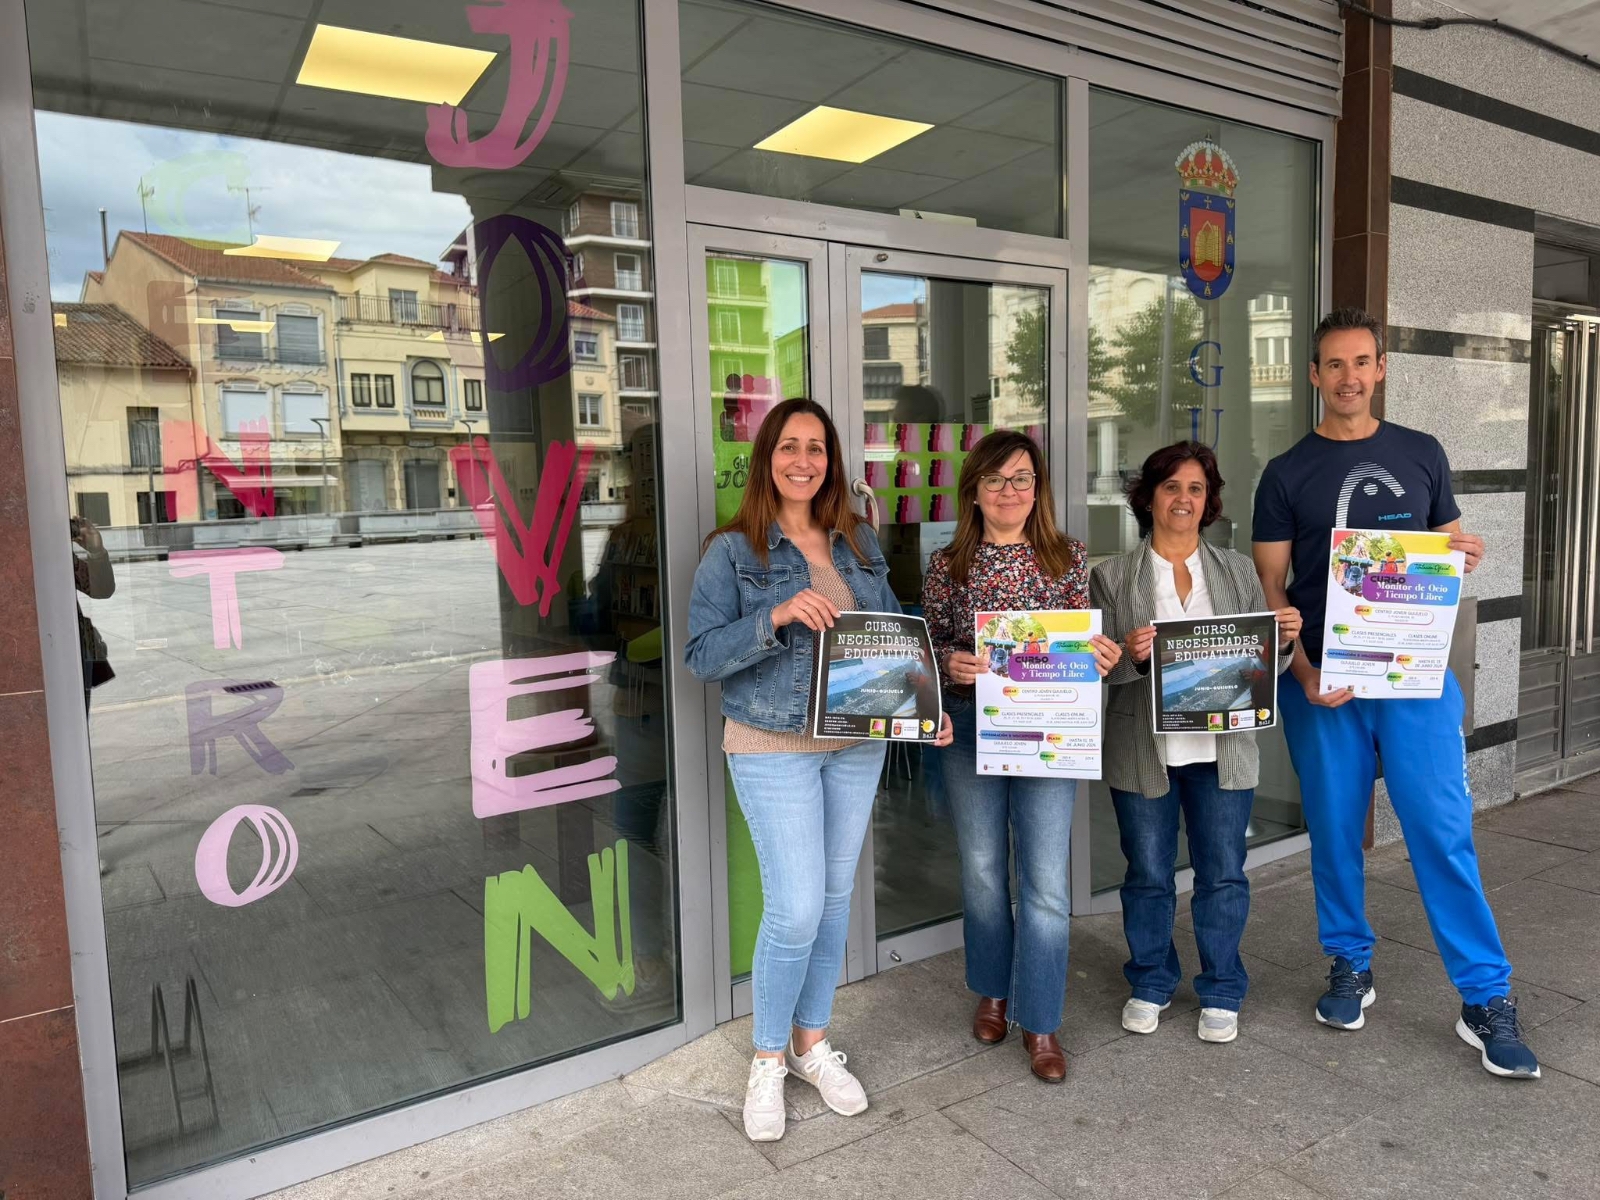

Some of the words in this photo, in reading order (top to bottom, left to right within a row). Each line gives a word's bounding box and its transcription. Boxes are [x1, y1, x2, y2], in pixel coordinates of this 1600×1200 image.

[1378, 512, 1412, 521] HEAD
[1370, 575, 1406, 584] CURSO
[1377, 581, 1412, 591] Monitor
[1415, 583, 1425, 592] de
[1428, 584, 1448, 593] Ocio
[1375, 592, 1381, 600] y
[1384, 590, 1418, 601] Tiempo
[1420, 592, 1444, 601] Libre
[865, 621, 901, 632] CURSO
[1193, 624, 1236, 635] CURSO
[837, 634, 920, 647] NECESIDADES
[1167, 635, 1259, 650] NECESIDADES
[844, 648, 920, 660] EDUCATIVAS
[1175, 648, 1256, 662] EDUCATIVAS
[1015, 656, 1049, 664] CURSO
[1021, 662, 1056, 670] Monitor
[1057, 662, 1067, 670] de
[1070, 662, 1089, 670] Ocio
[1021, 671, 1027, 679] y
[1029, 669, 1061, 680] Tiempo
[1062, 669, 1085, 679] Libre
